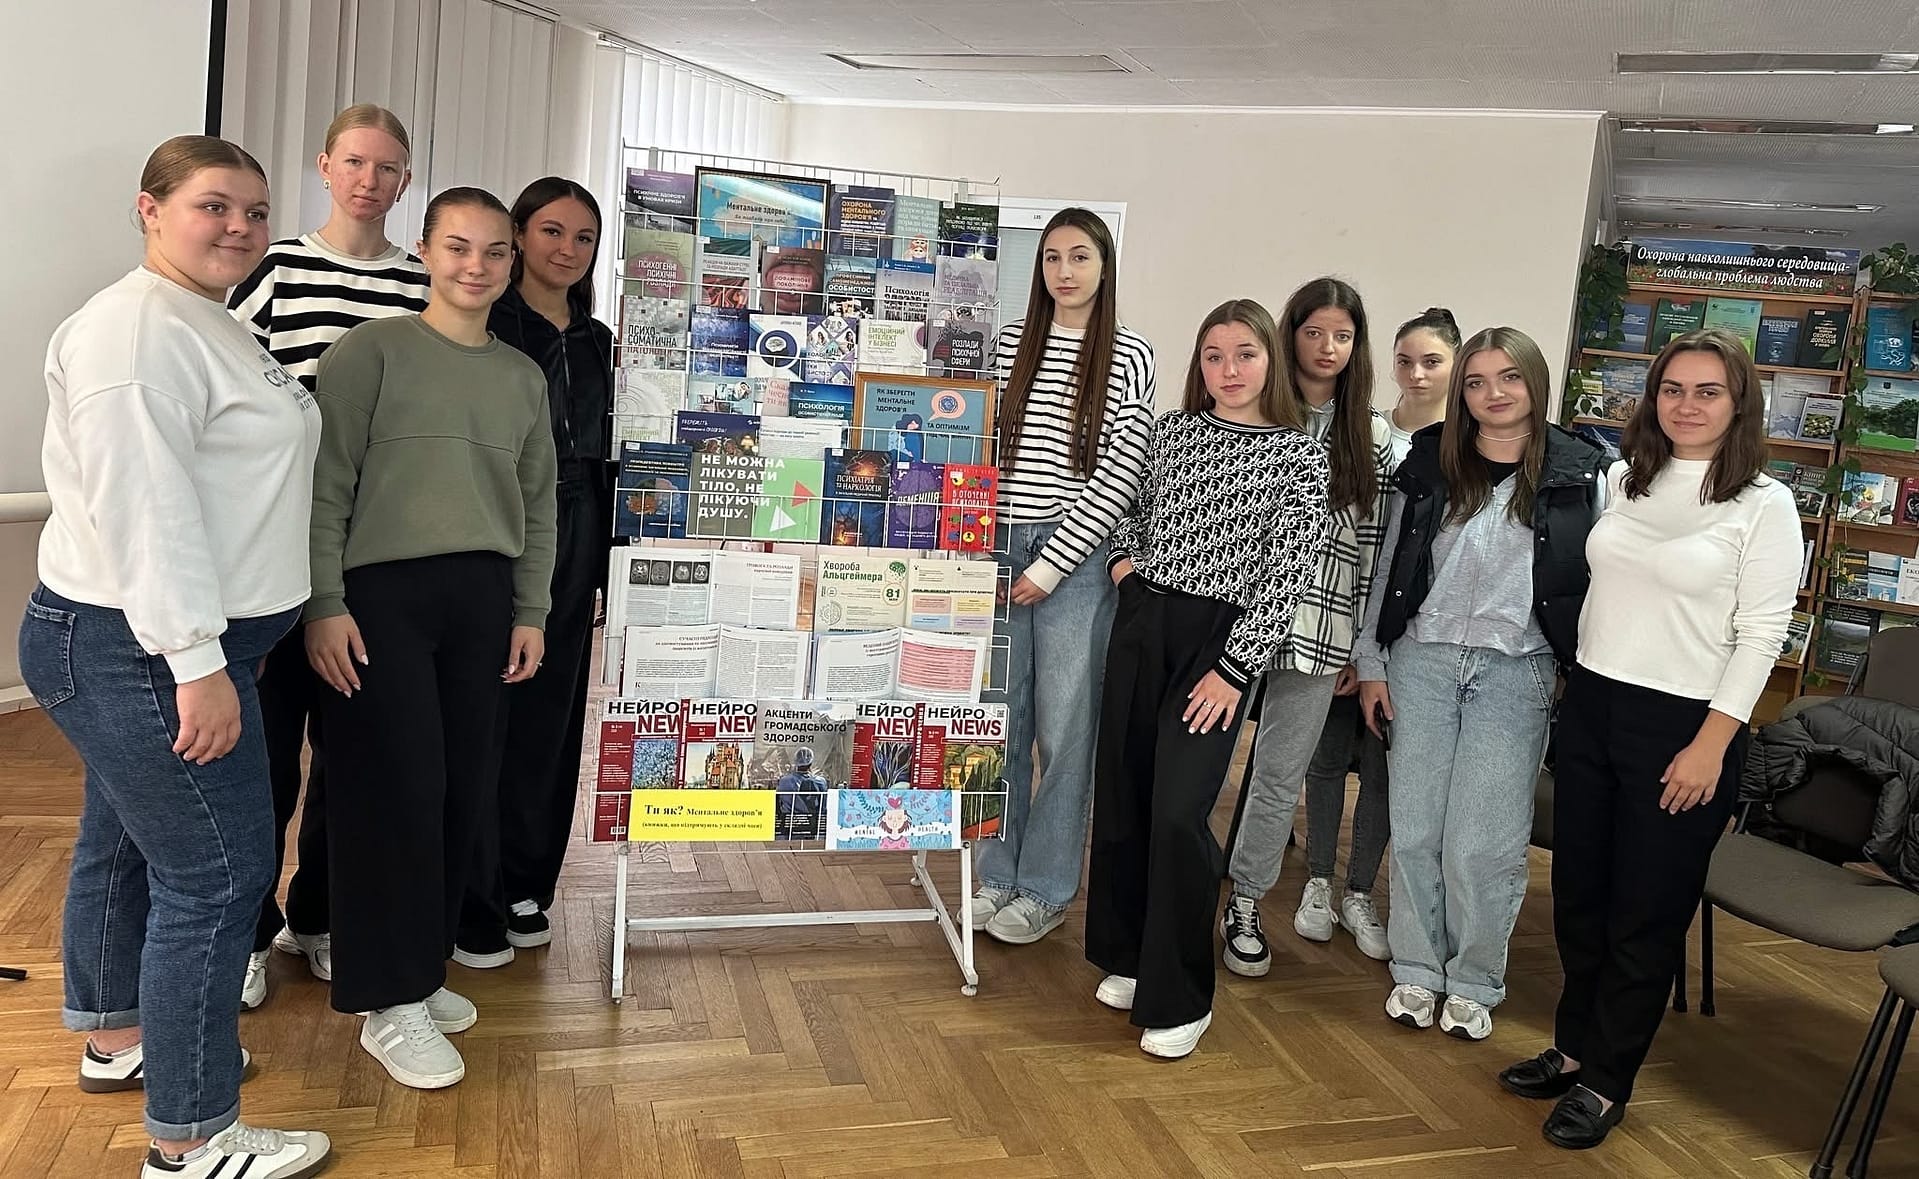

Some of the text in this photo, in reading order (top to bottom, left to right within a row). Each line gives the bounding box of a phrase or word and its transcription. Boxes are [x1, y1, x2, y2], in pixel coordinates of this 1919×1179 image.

[726, 202, 762, 213] Ментальне
[841, 207, 886, 216] МЕНТАЛЬНОГО
[638, 260, 677, 271] ПСИХОГЕННІ
[1637, 246, 1851, 276] Охорона навколишнього середовища-
[647, 269, 677, 280] ПСИХІЧНІ
[1656, 265, 1824, 289] глобальна проблема людства
[828, 285, 875, 294] ОСОБИСТОСТ
[885, 286, 930, 297] Психологія
[628, 324, 660, 336] ПСИХО-
[627, 335, 677, 347] СОМАТИЧНА
[868, 333, 897, 341] ІНТЕЛЕКТ
[952, 339, 979, 349] РОЗЛАДИ
[951, 348, 980, 358] ПСИХІЧНОЇ
[951, 357, 971, 366] СФЕРИ
[886, 389, 916, 397] ЗБЕРЕГТИ
[877, 397, 915, 406] МЕНТАЛЬНЕ
[798, 402, 845, 413] ПСИХОЛОГІЯ
[935, 423, 970, 431] ОПТИМІЗМ
[701, 454, 785, 469] НЕ МОЖНА
[700, 467, 777, 481] ЛІКУВАТИ
[836, 474, 875, 484] ПСИХІАТРІЯ
[699, 480, 764, 493] ТІЛО, НЕ
[842, 483, 882, 493] НАРКОЛОГІЯ
[699, 494, 770, 507] ЛІКУЮЧИ
[959, 490, 990, 500] ОТОЧЕННІ
[698, 507, 749, 519] ДУШУ.
[823, 560, 861, 571] Хвороба
[822, 570, 883, 583] Альцгеймера
[886, 588, 900, 598] 81
[608, 699, 680, 714] НЕЙРО
[692, 701, 757, 715] НЕЙРО
[856, 702, 916, 718] НЕЙРО
[928, 705, 986, 719] НЕЙРО
[764, 709, 813, 720] АКЦЕНТИ
[637, 714, 680, 733] NEW
[719, 715, 757, 733] NEW
[764, 721, 847, 733] ГРОМАДСЬКОГО
[877, 717, 915, 736] NEW
[951, 719, 1002, 736] NEWS
[763, 733, 815, 743] ЗДОРОВ'Я
[644, 804, 660, 815] Ти
[663, 805, 684, 816] як?
[687, 808, 729, 816] Ментальне
